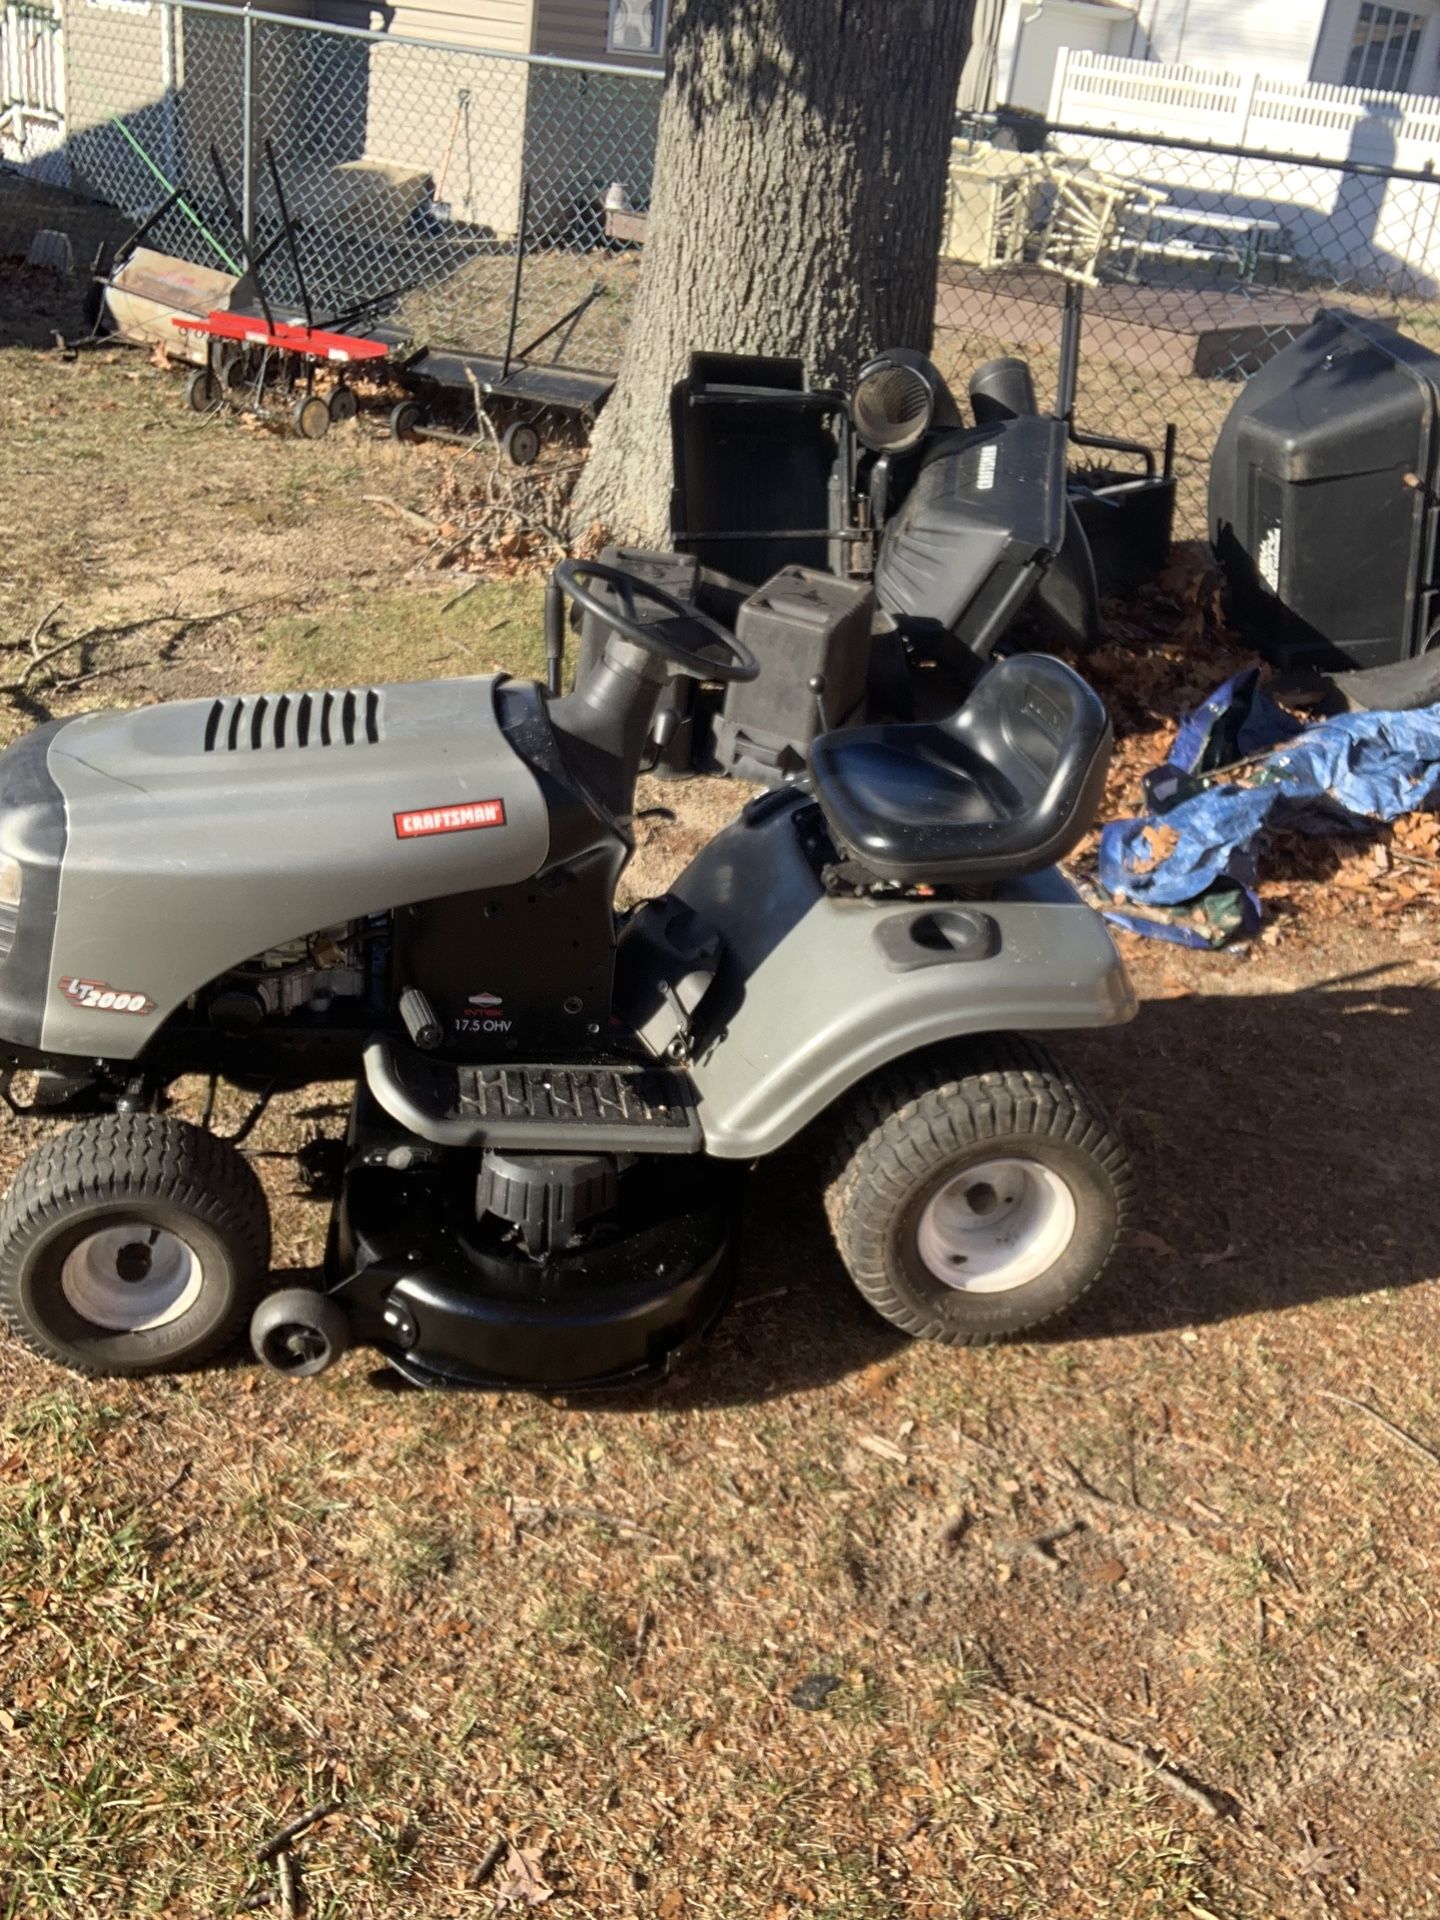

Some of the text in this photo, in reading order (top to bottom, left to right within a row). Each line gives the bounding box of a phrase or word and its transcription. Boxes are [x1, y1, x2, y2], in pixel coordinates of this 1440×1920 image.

[402, 804, 498, 833] CRAFTSMAN
[455, 1018, 512, 1032] 17.5 OHV
